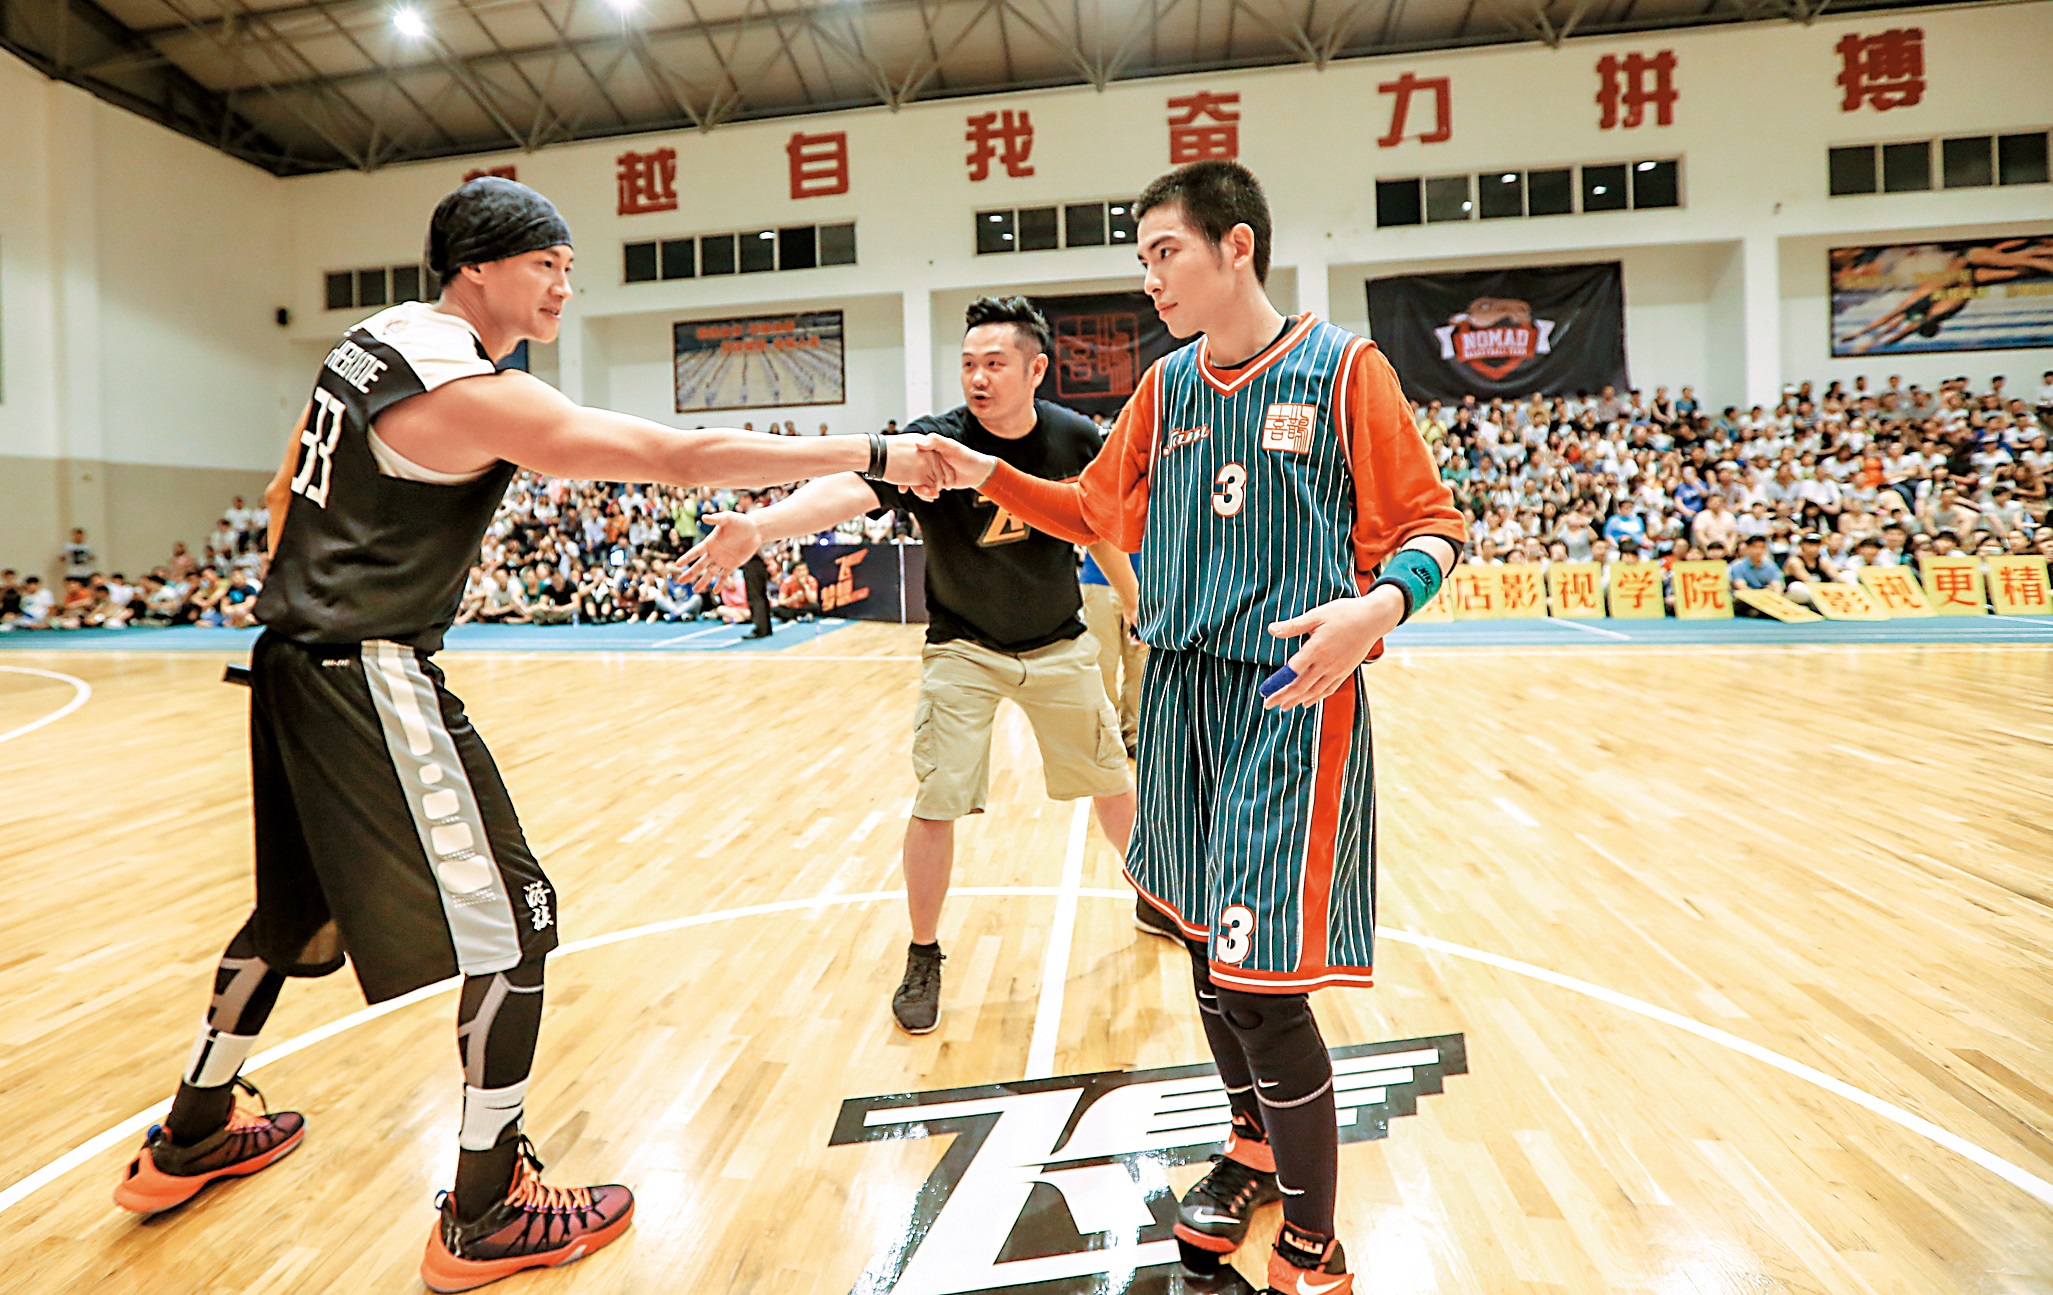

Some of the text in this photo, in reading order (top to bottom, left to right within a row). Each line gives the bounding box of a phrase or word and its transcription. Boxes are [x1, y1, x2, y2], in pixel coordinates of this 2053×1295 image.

[1462, 328, 1530, 350] NOMAD
[1211, 462, 1248, 517] 3
[1216, 903, 1257, 965] 3
